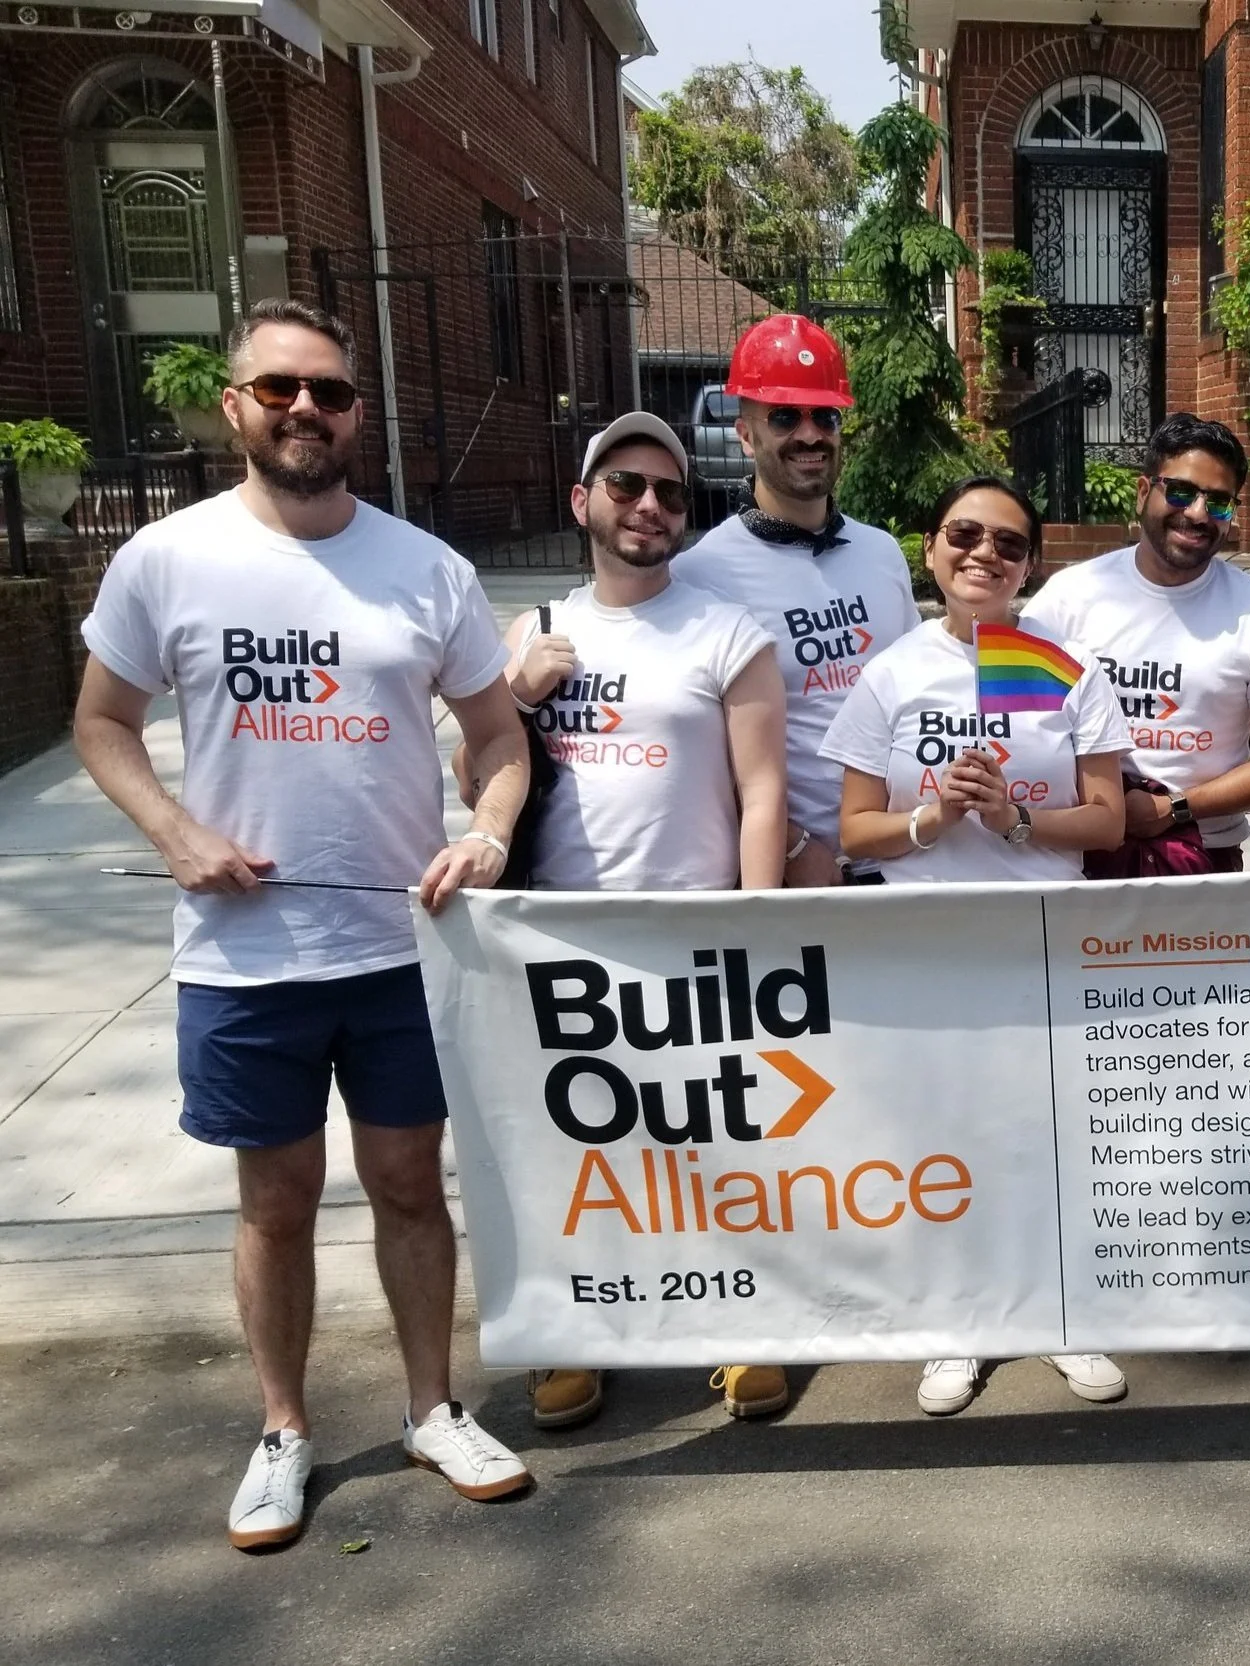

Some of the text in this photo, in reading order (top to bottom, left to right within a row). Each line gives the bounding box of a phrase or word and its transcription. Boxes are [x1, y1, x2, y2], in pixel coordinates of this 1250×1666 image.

[783, 594, 869, 640] Build
[222, 627, 340, 667] Build
[795, 629, 857, 667] Out
[225, 665, 312, 704] Out
[557, 673, 627, 702] uild
[803, 659, 863, 696] Allia
[1096, 656, 1182, 692] Build
[535, 702, 599, 734] Out
[1118, 692, 1156, 719] ut
[231, 703, 390, 743] Alliance
[918, 711, 1012, 739] Build
[1129, 719, 1213, 752] iance
[546, 733, 668, 767] Alliance
[1080, 930, 1250, 956] Our Mission
[525, 944, 832, 1051] Build
[1084, 986, 1144, 1010] Build
[1152, 985, 1197, 1007] Out
[1085, 1018, 1210, 1041] advocates
[1216, 1016, 1250, 1037] for
[1085, 1048, 1234, 1076] transgender,
[543, 1053, 764, 1145] Out
[1087, 1081, 1168, 1108] openly
[1175, 1079, 1219, 1101] and
[1089, 1112, 1183, 1138] building
[1091, 1144, 1203, 1165] Members
[562, 1147, 973, 1237] Alliance
[1092, 1181, 1152, 1197] more
[1092, 1207, 1130, 1228] We
[1138, 1206, 1187, 1228] lead
[1195, 1206, 1224, 1231] by
[570, 1269, 756, 1304] Est. 2018
[1095, 1269, 1144, 1289] with
